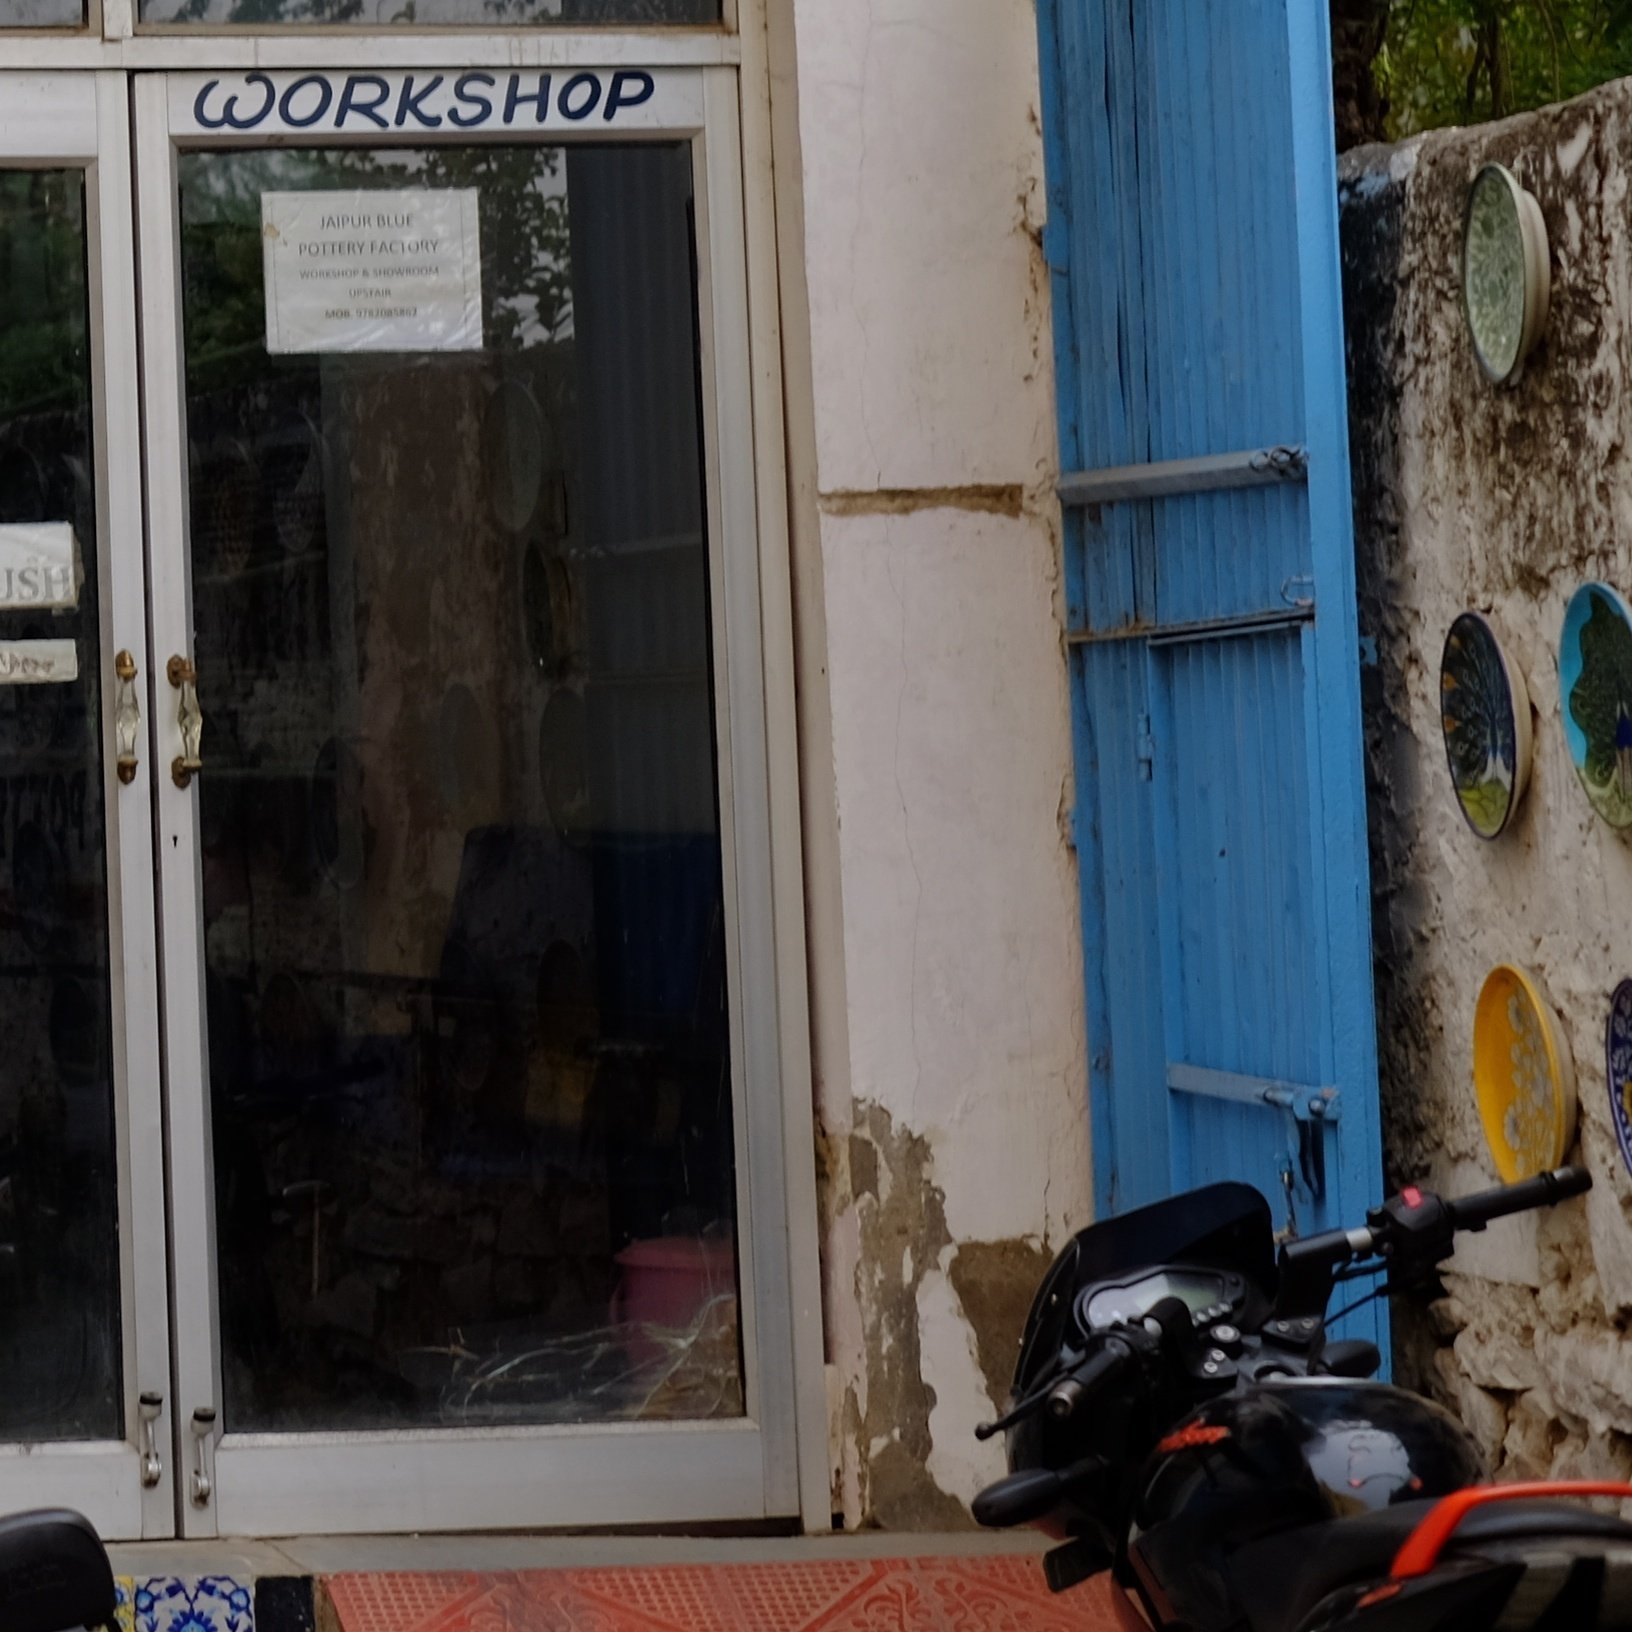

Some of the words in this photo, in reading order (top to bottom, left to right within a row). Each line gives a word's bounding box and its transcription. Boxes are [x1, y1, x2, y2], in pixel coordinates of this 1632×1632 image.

[193, 70, 655, 129] WORKSHOP
[320, 213, 372, 231] JAIPUR
[377, 213, 414, 229] BLUE
[298, 239, 366, 257] POTTERY
[371, 238, 440, 256] FACTORY
[299, 268, 360, 280] WORKSHOP
[372, 266, 440, 278] SHOWROOM
